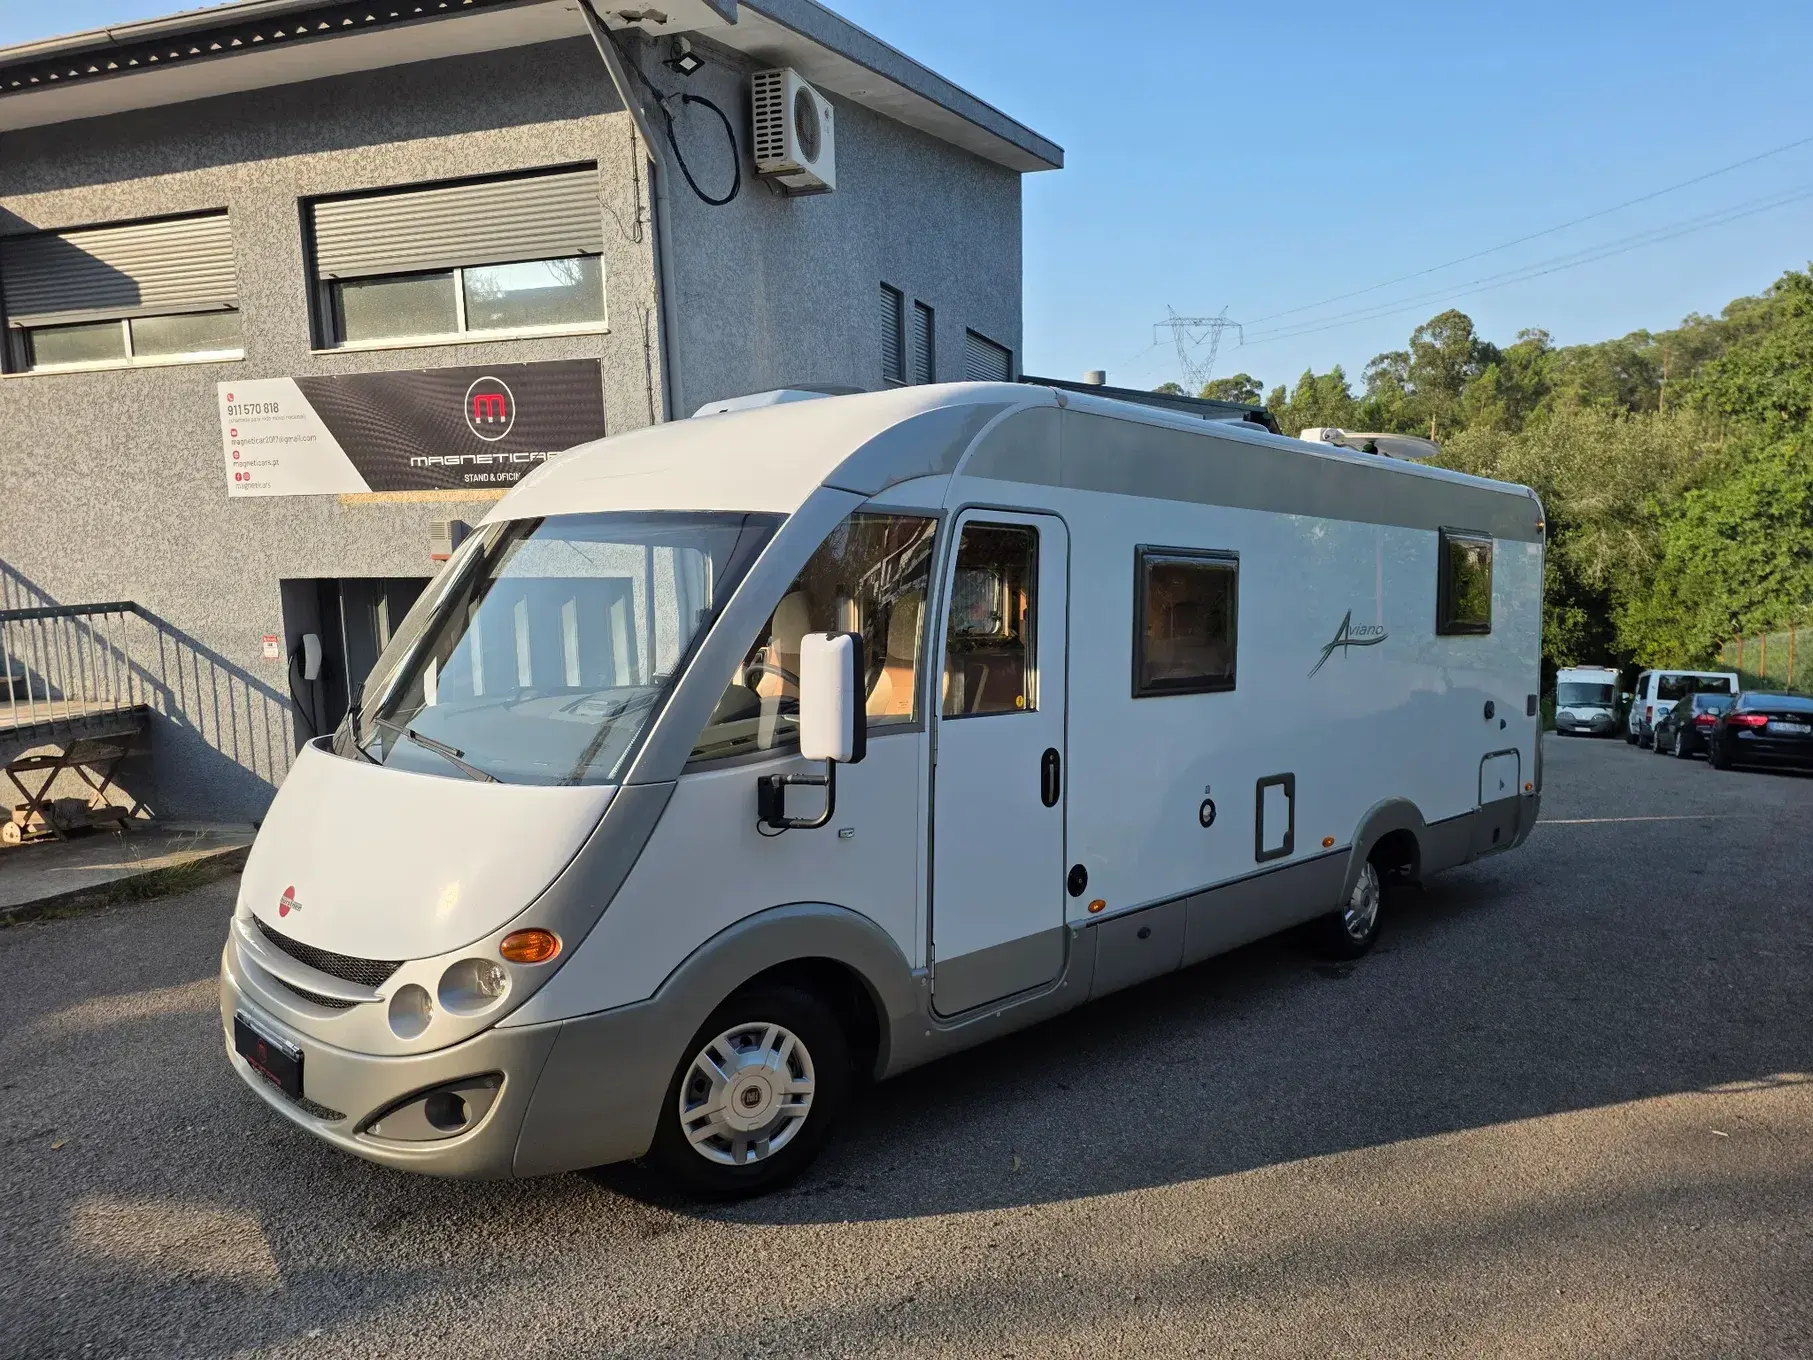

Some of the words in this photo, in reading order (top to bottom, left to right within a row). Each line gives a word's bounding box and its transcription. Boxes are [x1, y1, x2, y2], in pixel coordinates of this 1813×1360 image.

[227, 405, 242, 416] 911
[243, 403, 262, 415] 570
[263, 402, 279, 414] 818
[233, 458, 280, 468] magneticars.pt
[464, 473, 489, 483] STAND
[490, 473, 496, 481] &
[496, 472, 521, 482] OFICIN
[235, 481, 272, 490] magneticars
[1307, 607, 1390, 680] Aviano
